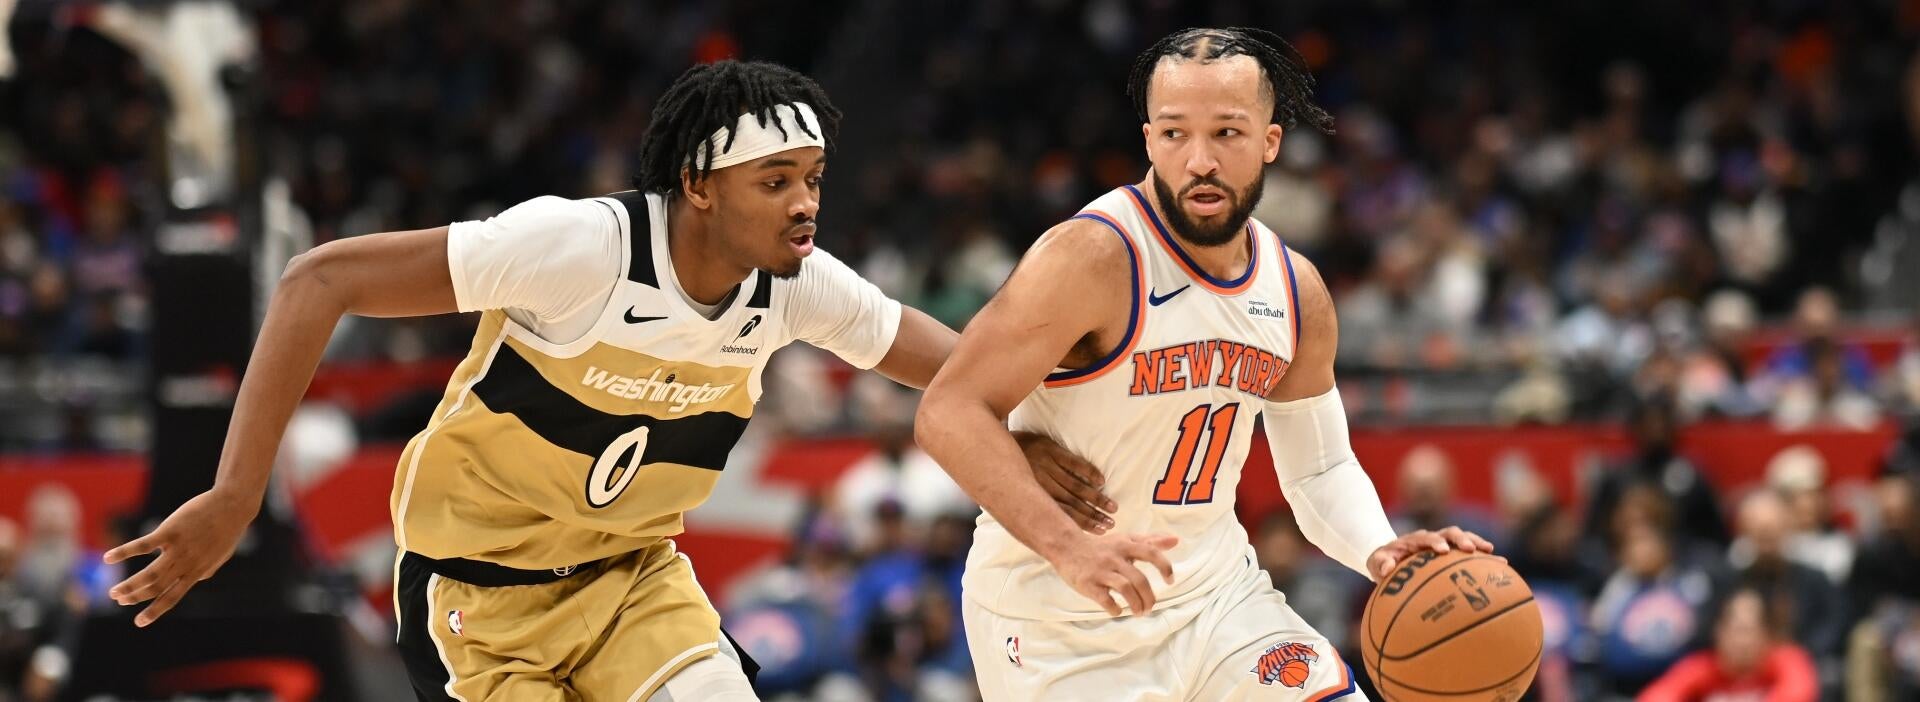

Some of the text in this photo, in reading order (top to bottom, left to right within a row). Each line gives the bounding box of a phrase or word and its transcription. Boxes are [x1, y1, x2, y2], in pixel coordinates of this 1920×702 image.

[1248, 306, 1284, 318] abu dhabi
[720, 345, 758, 355] Robinhood
[1129, 339, 1217, 397] NEW
[585, 425, 650, 509] 0
[1152, 402, 1240, 505] 11
